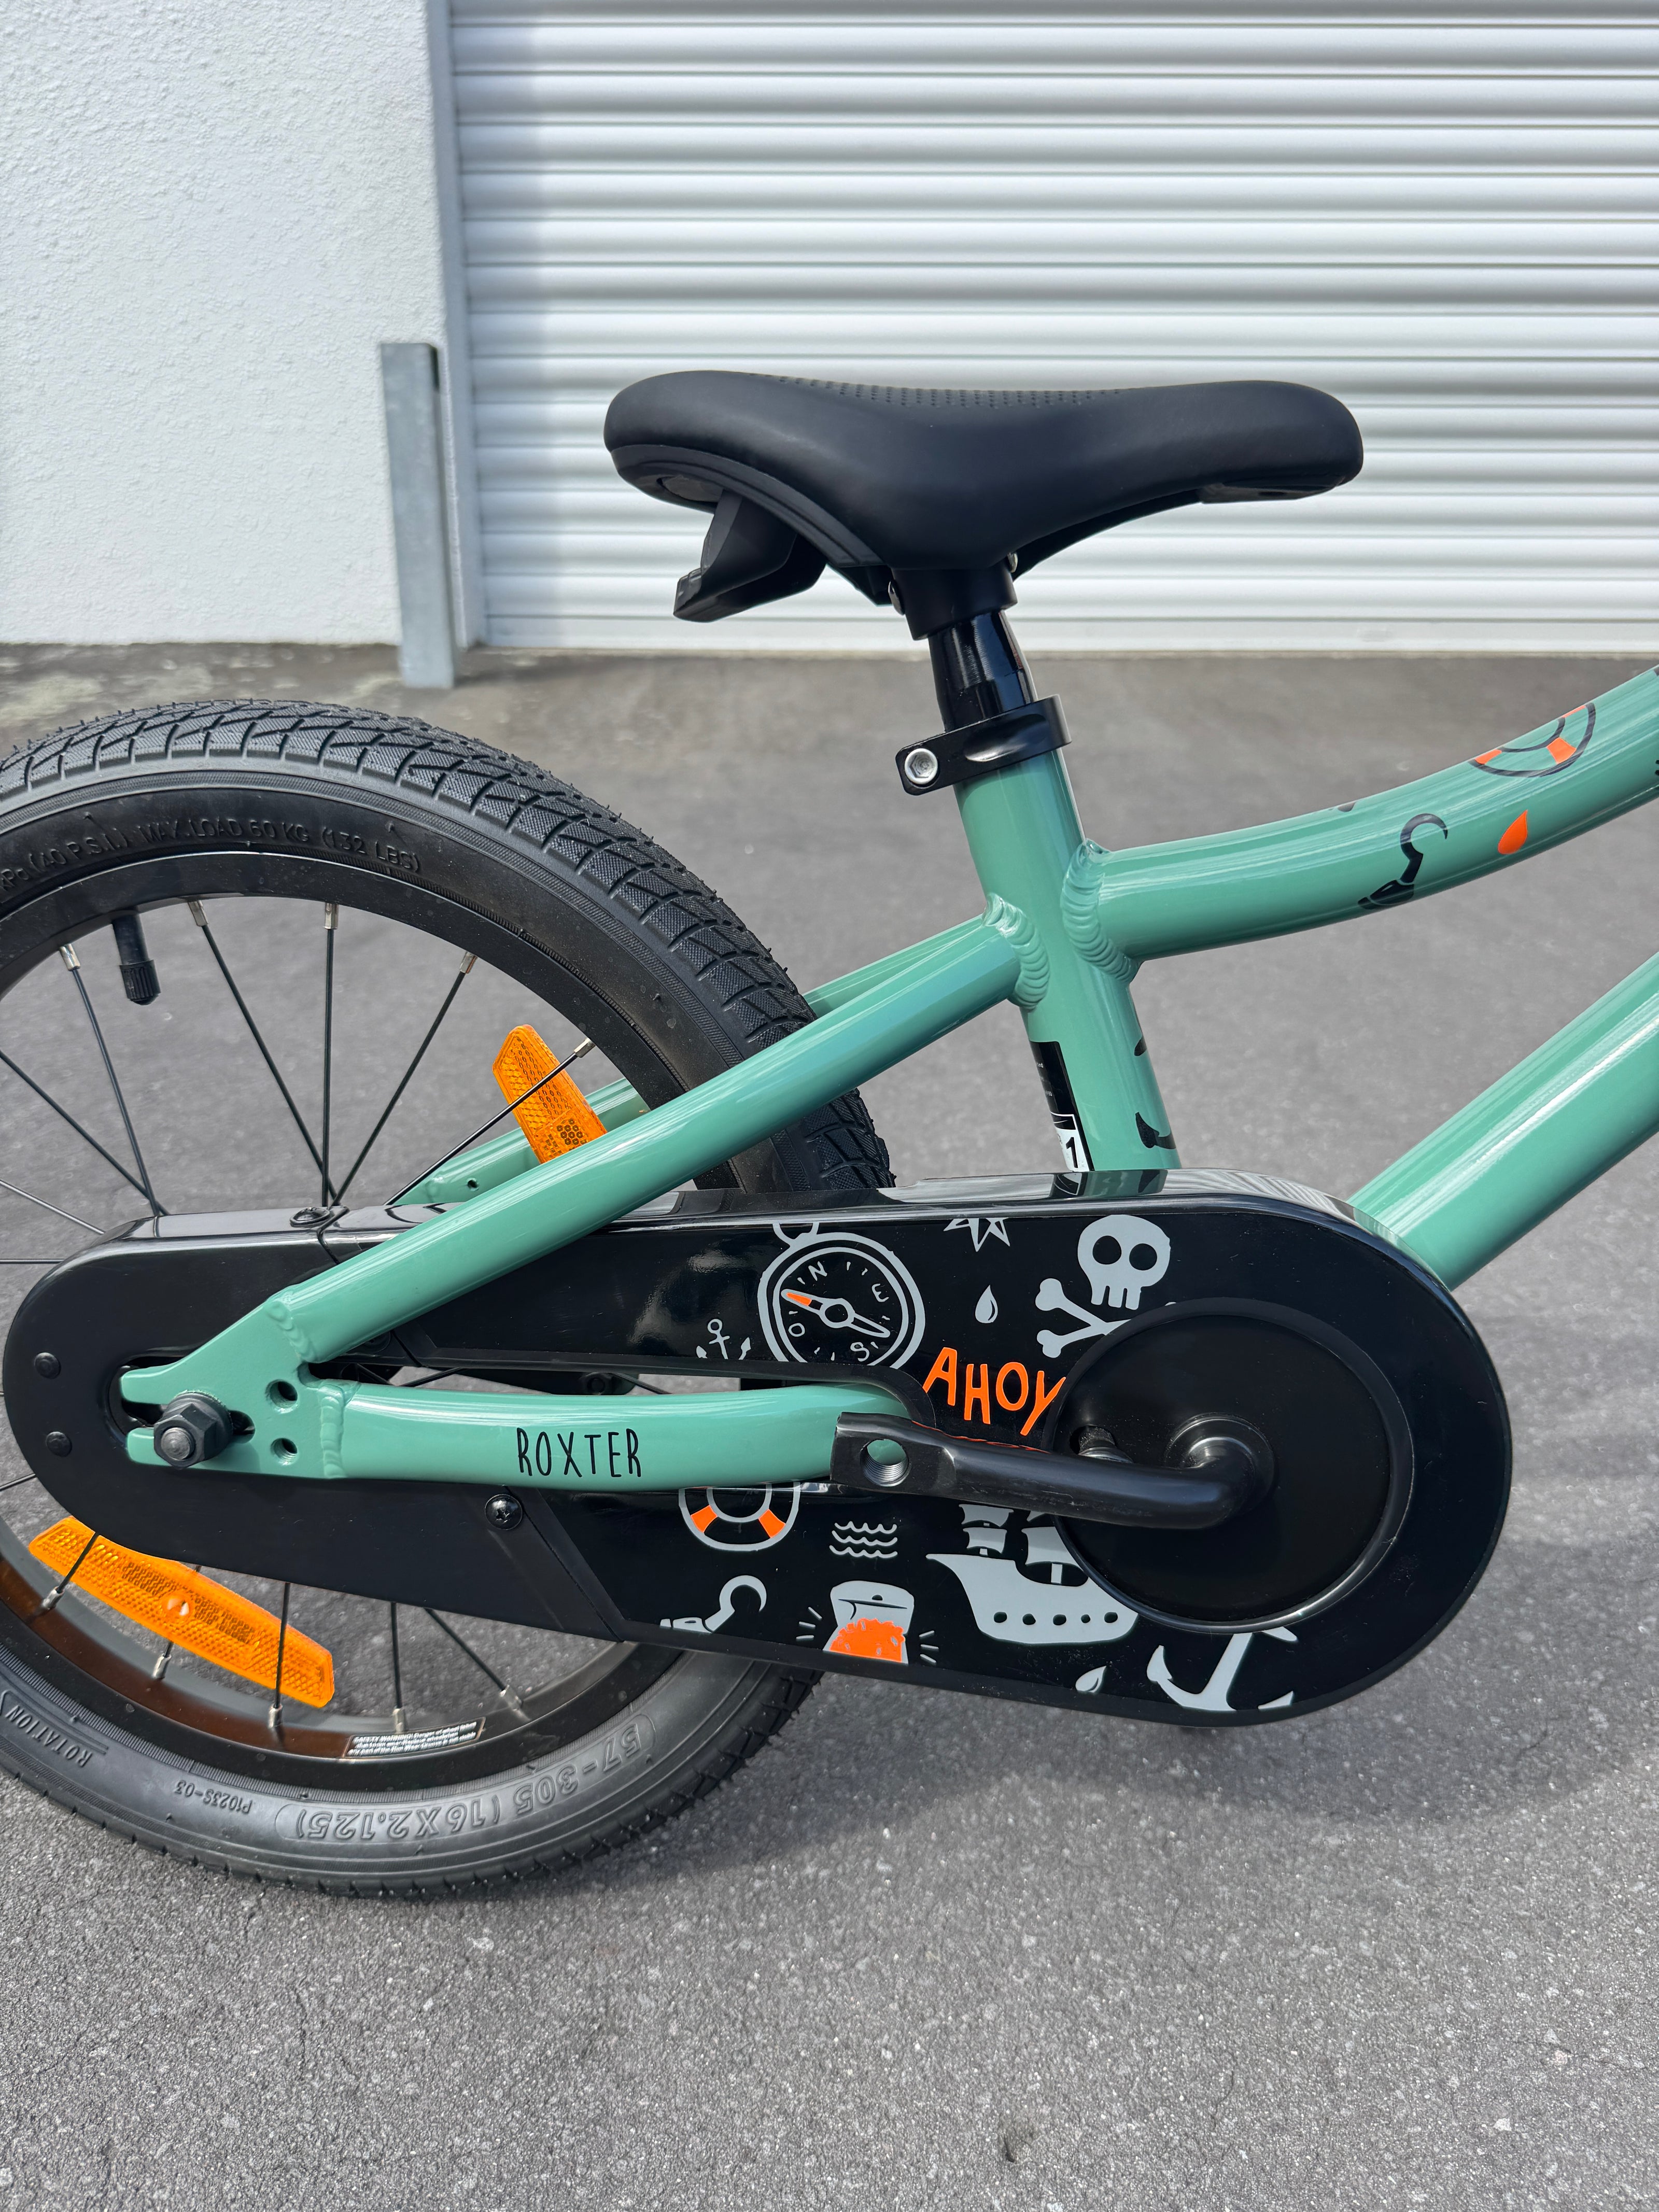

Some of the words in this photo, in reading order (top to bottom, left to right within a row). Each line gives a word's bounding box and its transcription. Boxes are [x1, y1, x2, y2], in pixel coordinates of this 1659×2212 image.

[249, 819, 276, 838] 60
[282, 821, 310, 842] KG
[321, 826, 365, 854] (132
[375, 840, 419, 872] LBS)
[808, 1261, 828, 1281] N
[871, 1283, 889, 1303] E
[788, 1322, 805, 1337] O
[850, 1342, 870, 1362] S
[922, 1346, 1066, 1436] AHOY
[516, 1427, 642, 1477] ROXTER
[4, 1704, 93, 1768] ROTATION
[513, 1723, 642, 1815] 57-305
